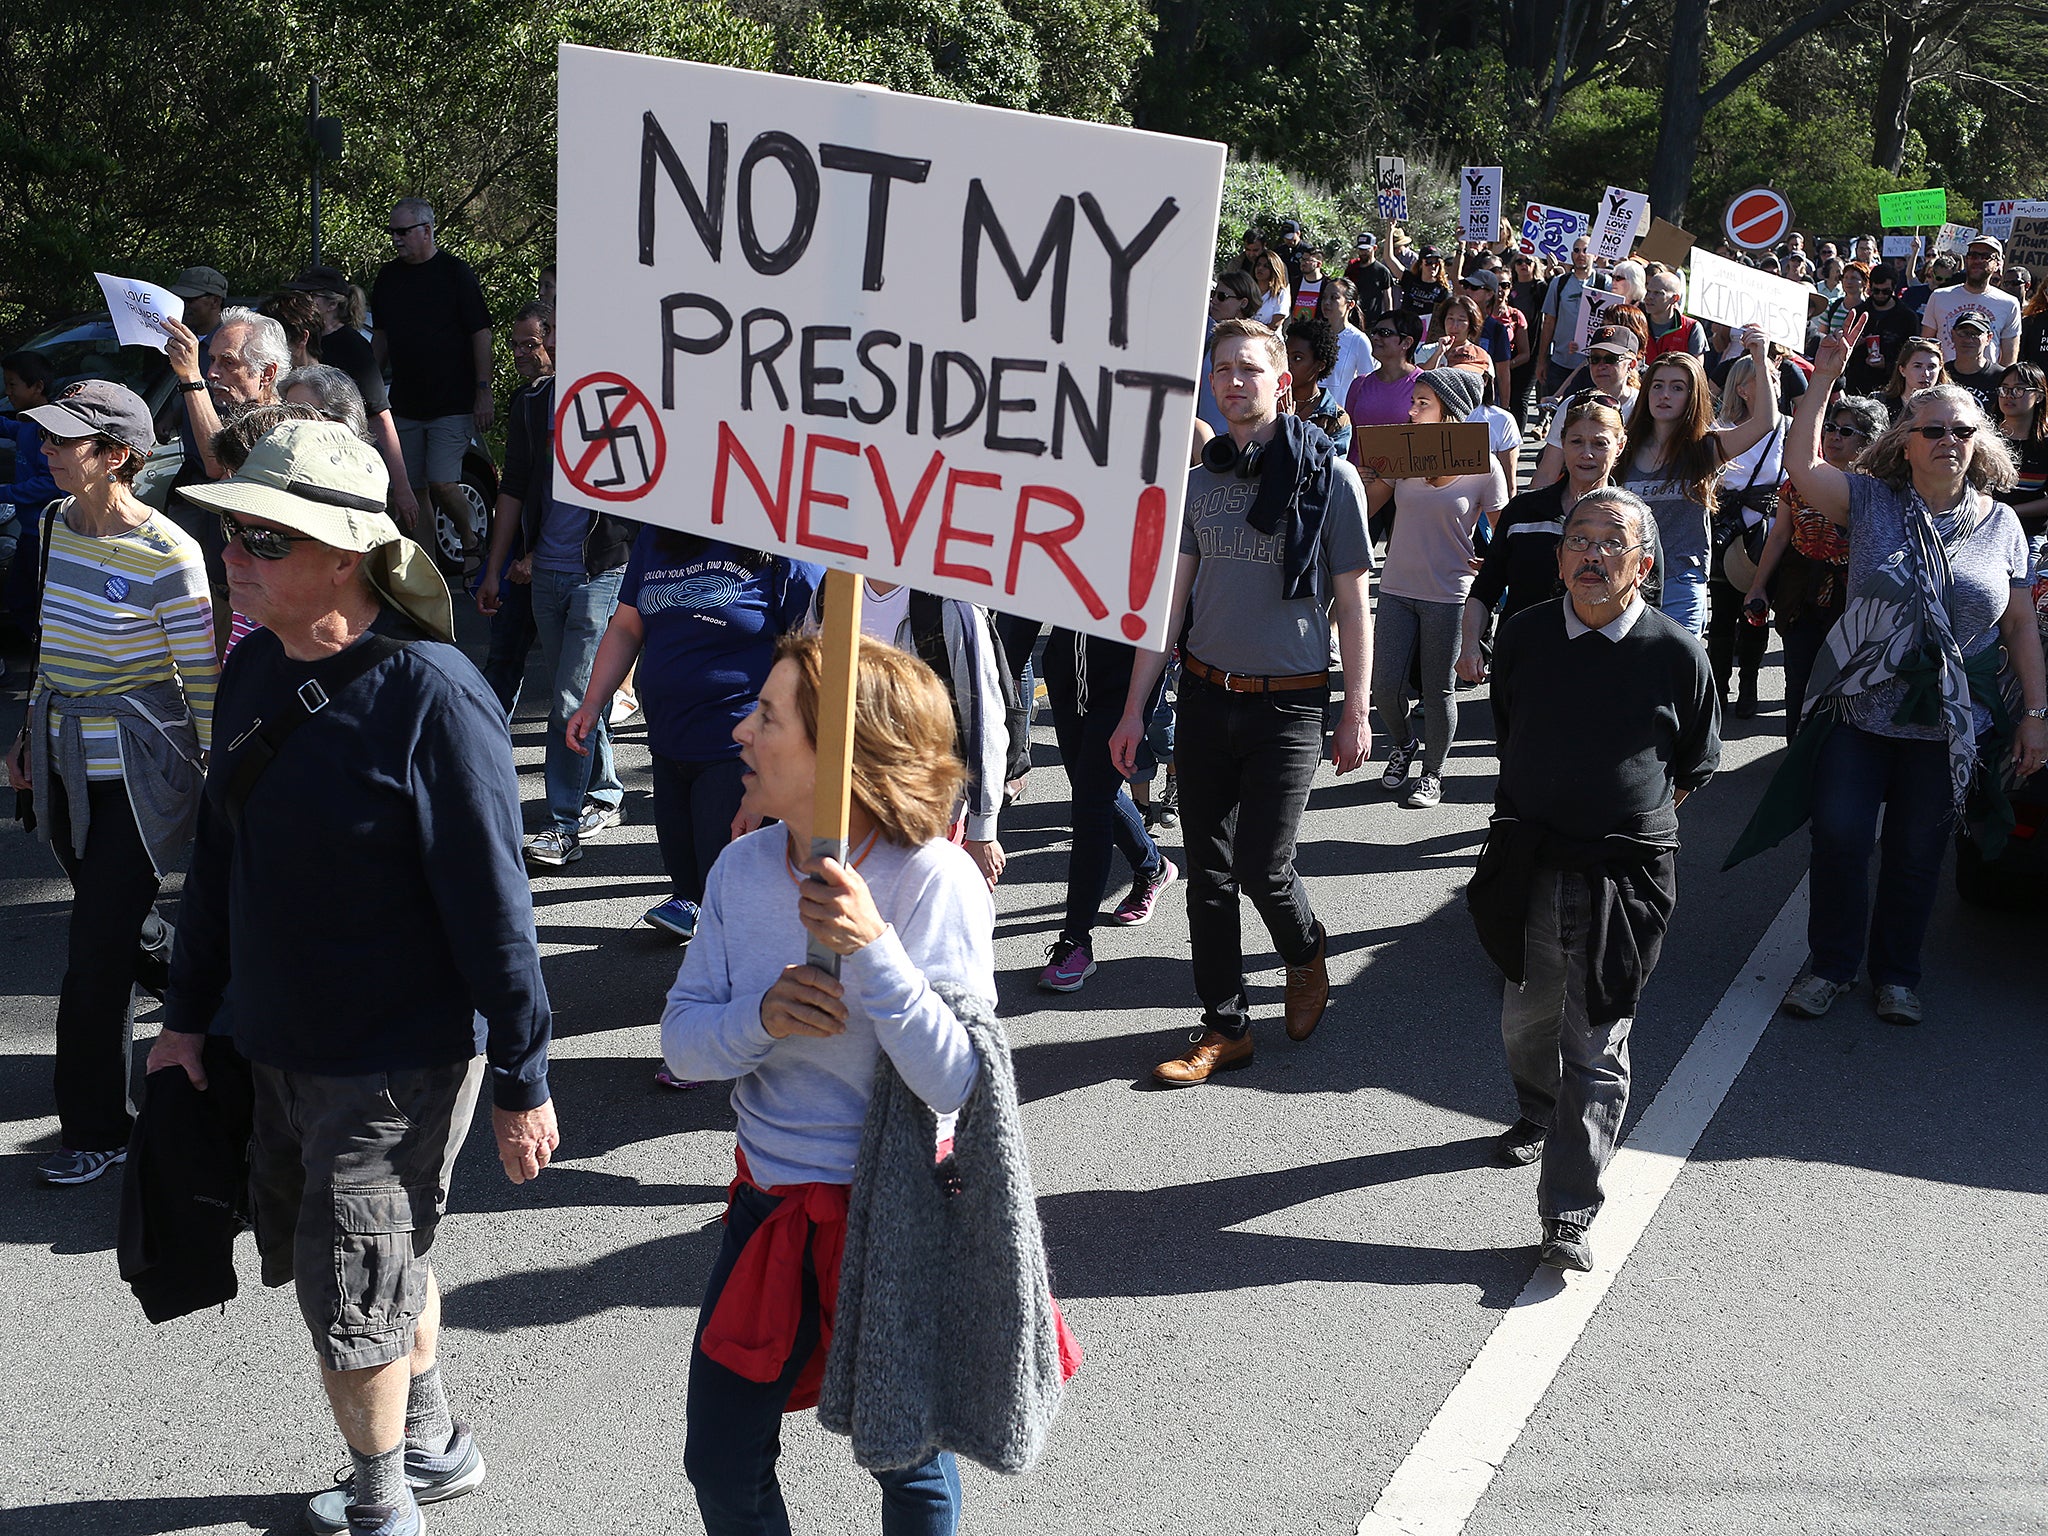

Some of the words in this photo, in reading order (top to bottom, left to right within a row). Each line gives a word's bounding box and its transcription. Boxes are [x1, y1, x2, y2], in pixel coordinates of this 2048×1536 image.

[1465, 175, 1491, 195] YES
[1608, 194, 1633, 220] YES
[1984, 203, 1996, 216] I
[638, 110, 931, 290] NOT
[961, 178, 1180, 348] MY
[1470, 214, 1489, 224] NO
[1520, 205, 1541, 254] USA
[1606, 220, 1628, 230] LOVE
[1539, 209, 1577, 262] Pray
[1602, 234, 1621, 245] NO
[1600, 244, 1618, 252] HATE
[123, 289, 151, 304] LOVE
[1585, 295, 1606, 318] YE
[1701, 277, 1802, 347] KINDNESS
[660, 292, 1195, 484] PRESIDENT
[1190, 483, 1260, 527] BOS
[711, 420, 1167, 642] NEVER!
[1194, 526, 1285, 566] OLLEG
[644, 570, 668, 582] FOLLOW
[668, 568, 686, 579] YOUR
[706, 560, 722, 570] FIND
[702, 615, 728, 627] BROOKS
